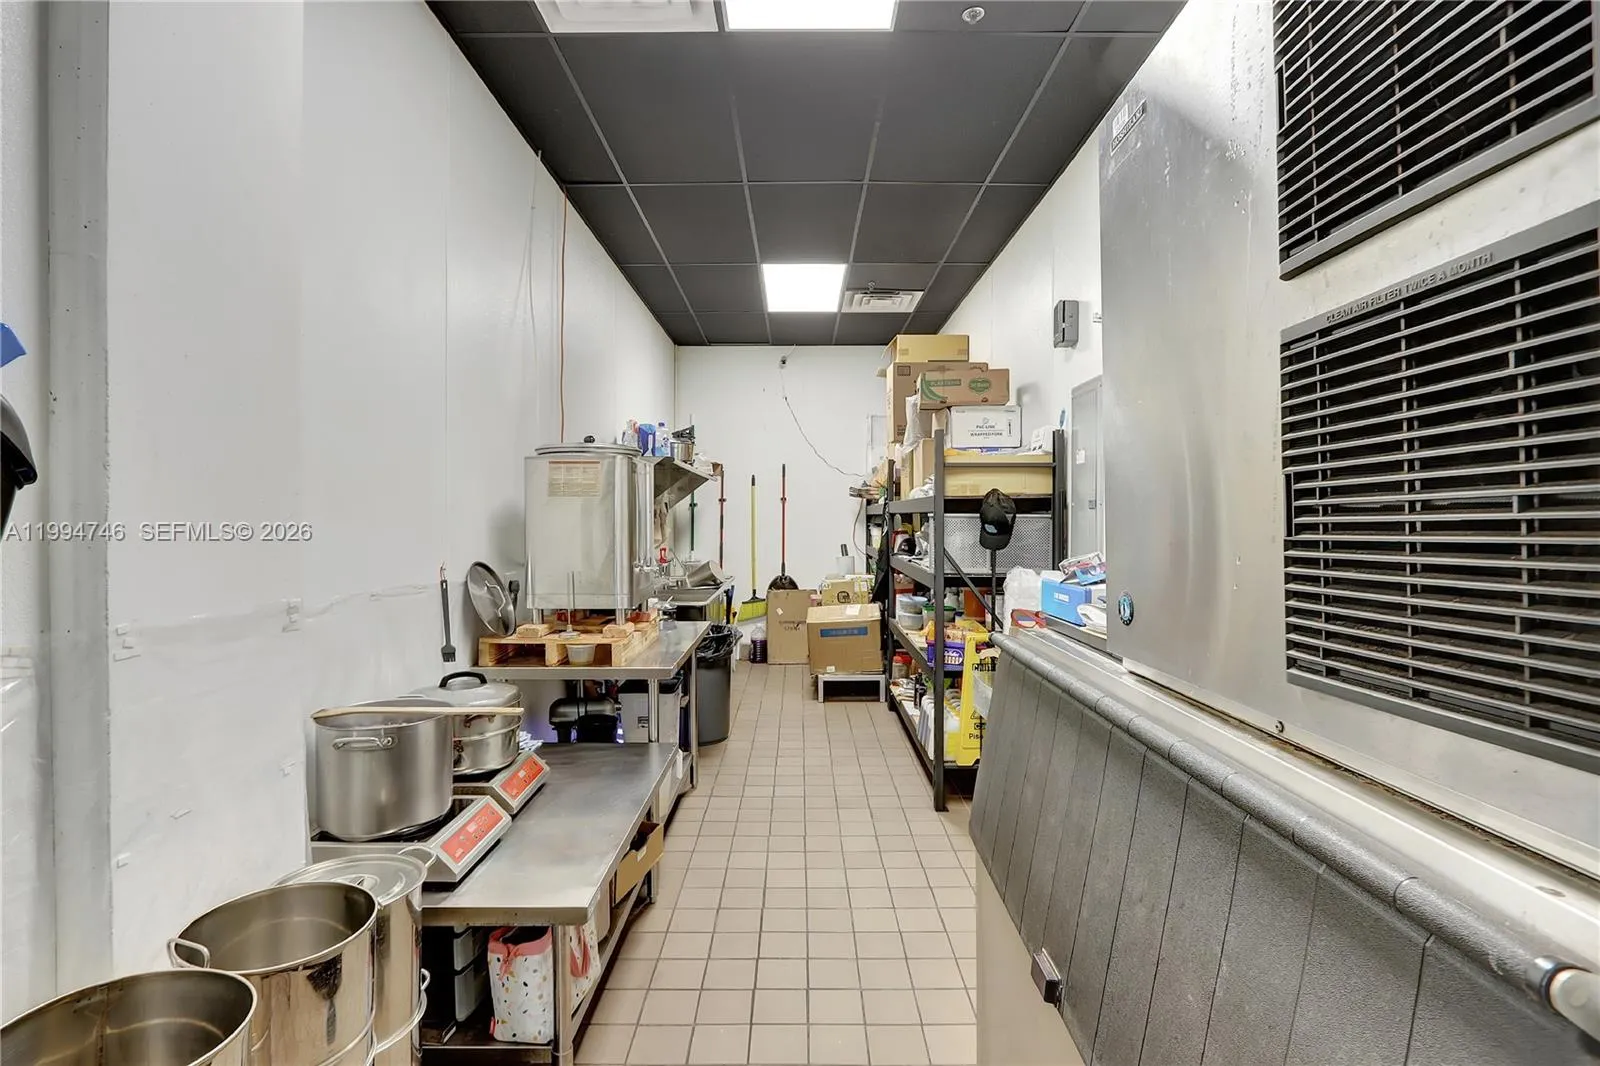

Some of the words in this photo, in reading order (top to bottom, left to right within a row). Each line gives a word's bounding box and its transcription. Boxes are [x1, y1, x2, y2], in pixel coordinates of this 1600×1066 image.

[1326, 307, 1353, 324] CLEAN
[1353, 301, 1369, 313] AIR
[1369, 288, 1402, 307] FILTER
[1404, 273, 1437, 293] TWICE
[1438, 271, 1448, 282] A
[1449, 251, 1494, 277] MONTH
